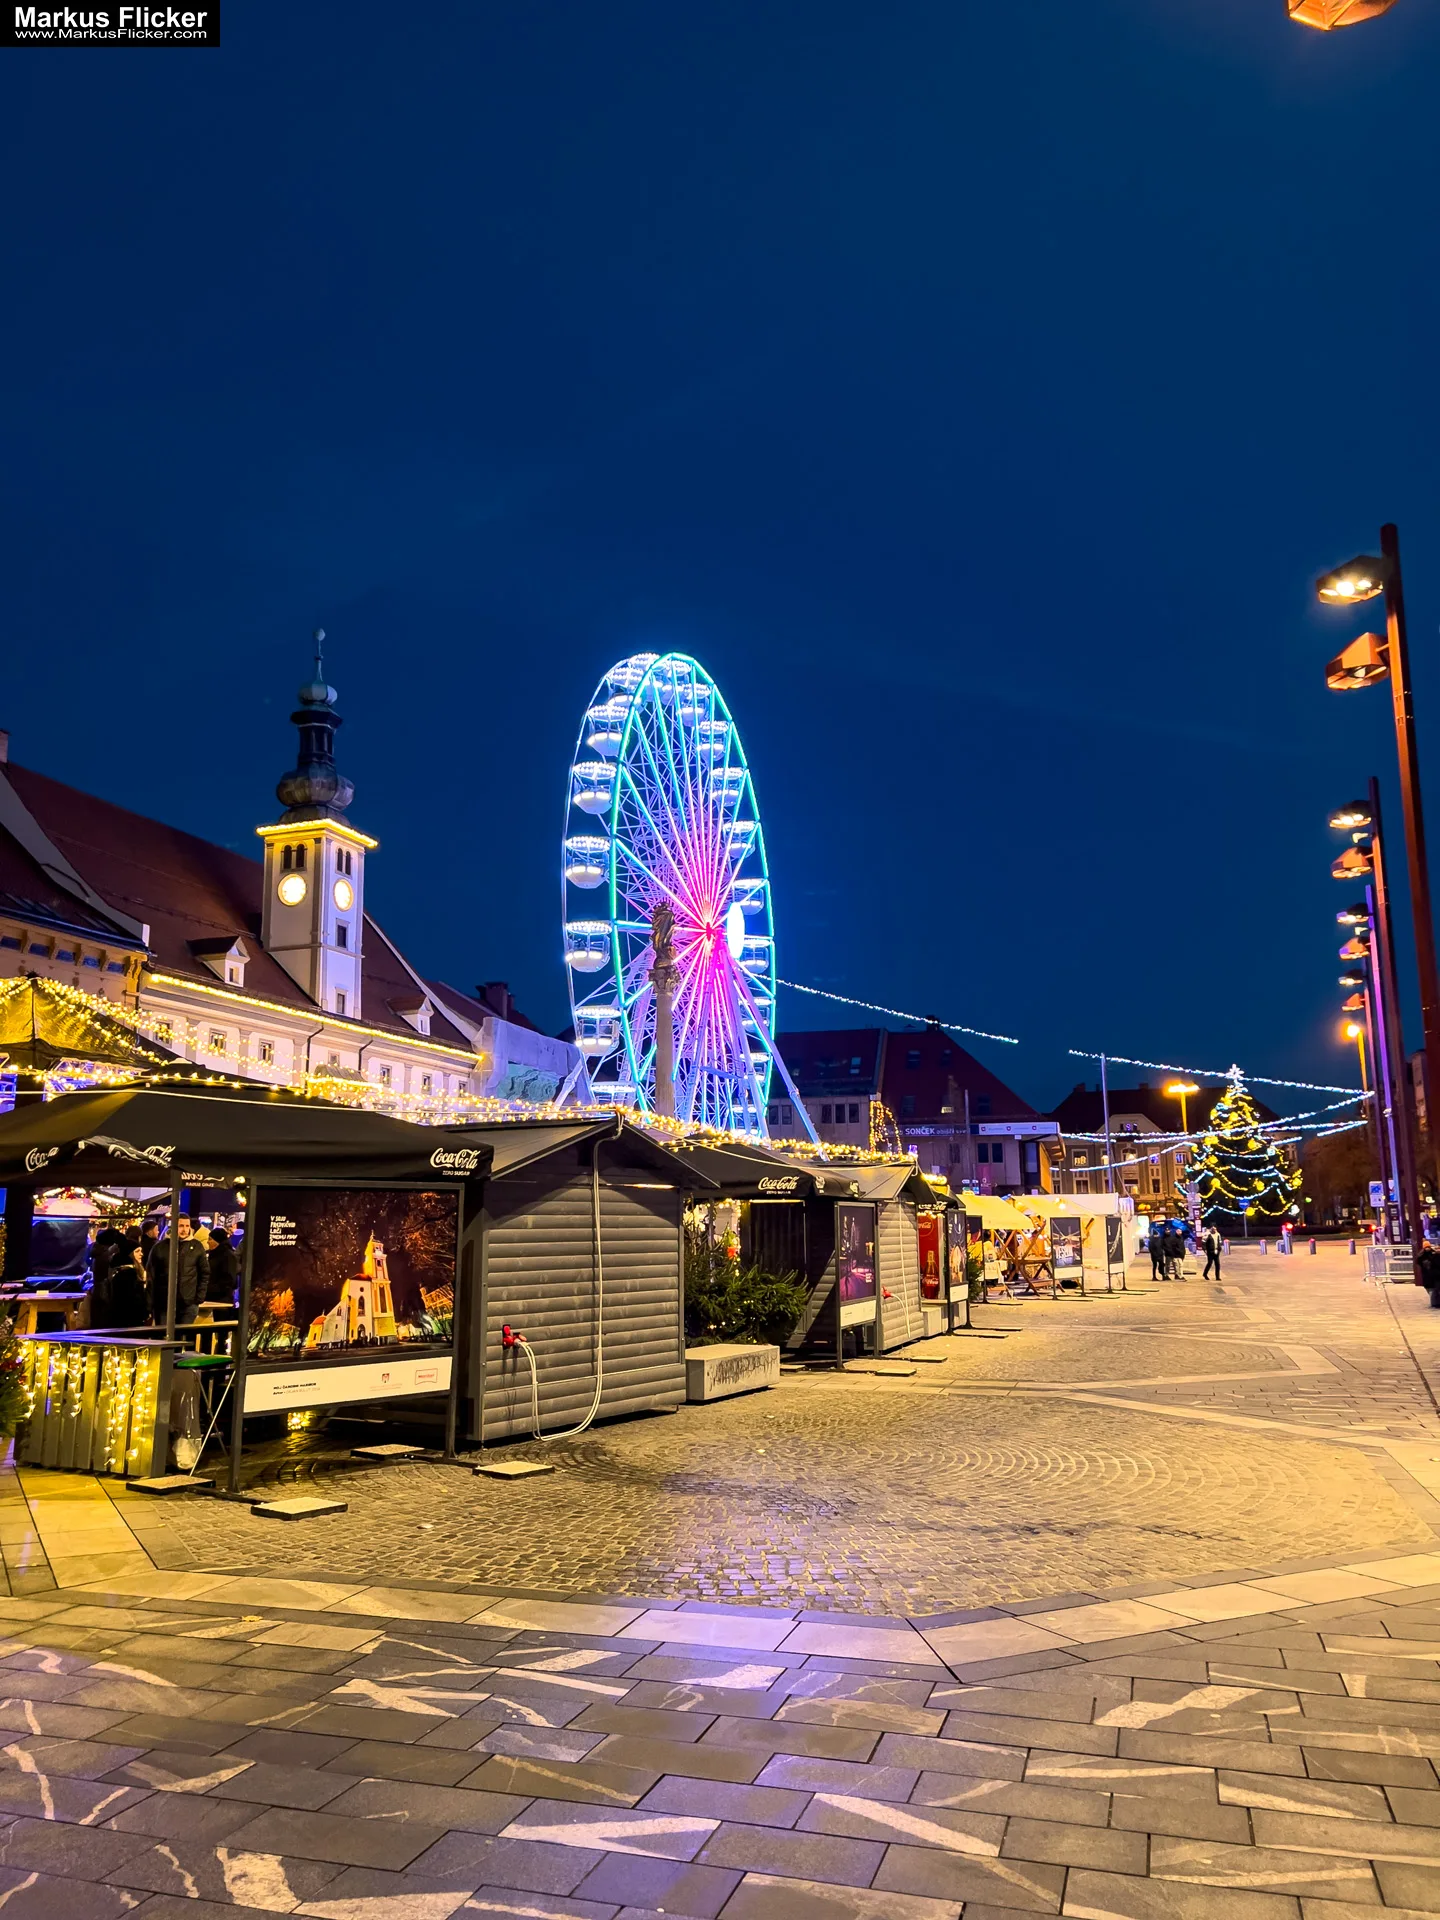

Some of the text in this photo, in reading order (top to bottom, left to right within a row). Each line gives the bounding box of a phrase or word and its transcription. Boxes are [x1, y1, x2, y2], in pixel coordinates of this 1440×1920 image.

[905, 1126, 935, 1135] SONČEK
[25, 1146, 60, 1172] Coca-C
[430, 1147, 481, 1170] Coca-Cola
[758, 1176, 800, 1190] Coca-Cola
